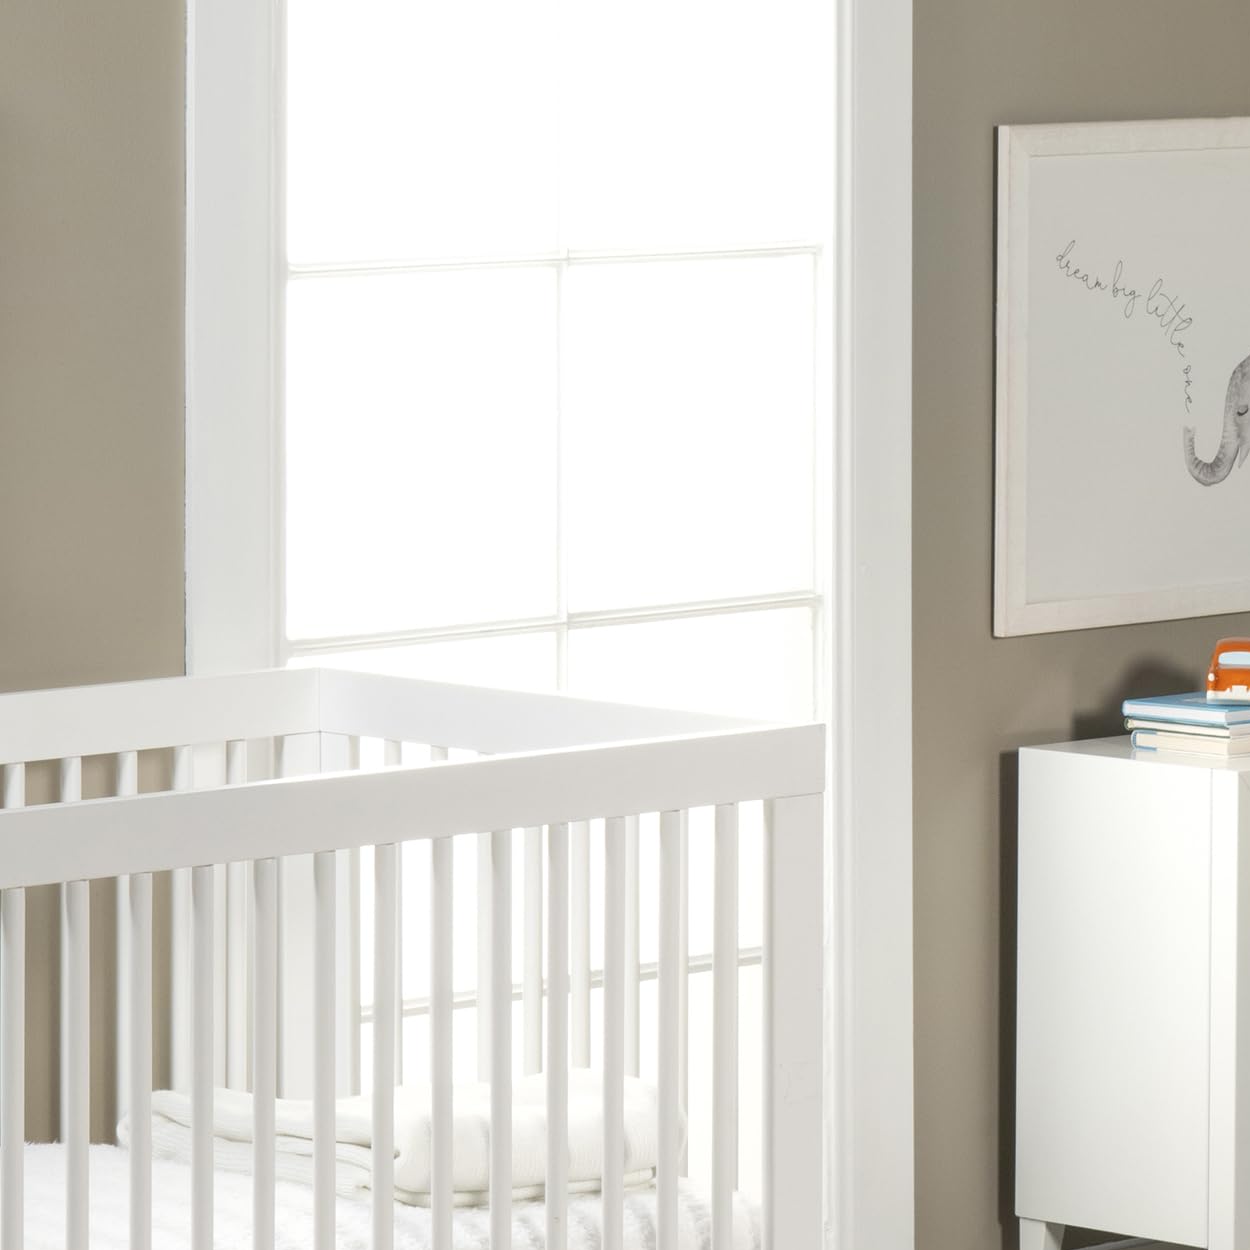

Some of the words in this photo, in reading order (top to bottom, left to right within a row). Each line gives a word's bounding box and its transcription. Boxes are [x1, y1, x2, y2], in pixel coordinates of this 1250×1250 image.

[1056, 240, 1107, 290] dream
[1112, 260, 1142, 318] big
[1146, 278, 1193, 358] little
[1182, 364, 1193, 414] one
